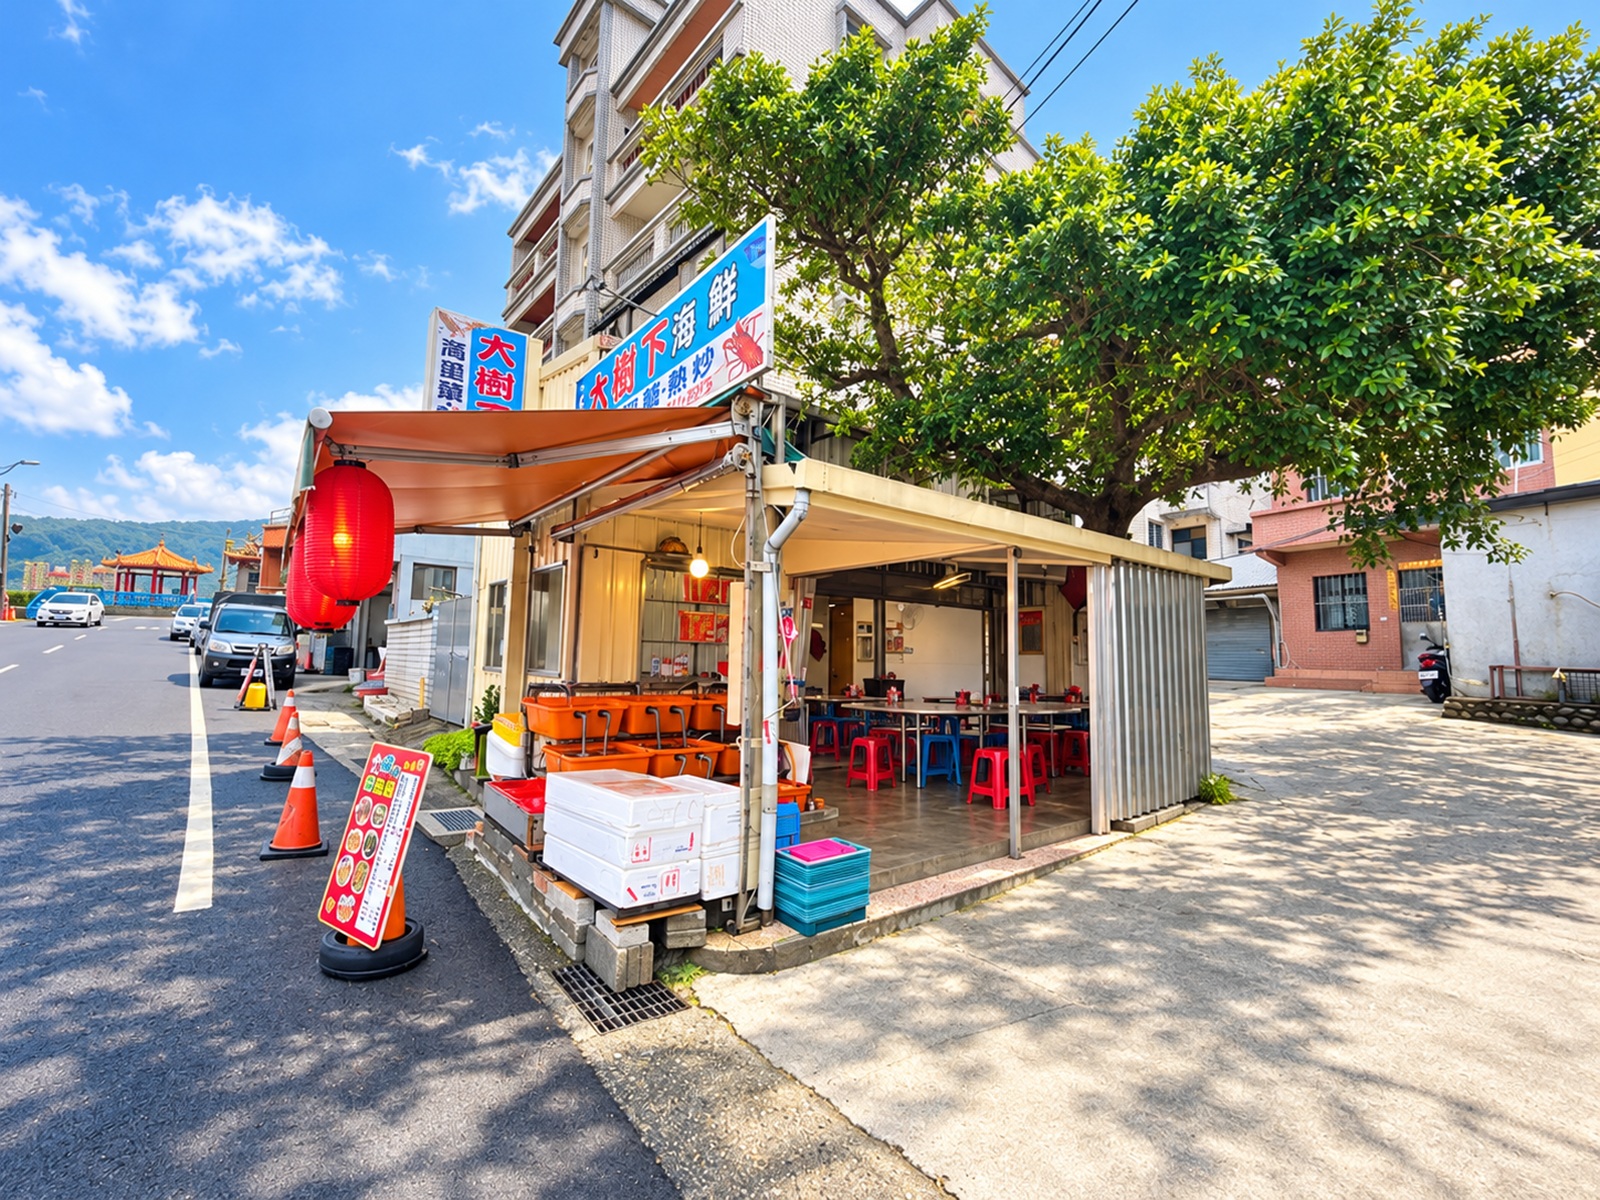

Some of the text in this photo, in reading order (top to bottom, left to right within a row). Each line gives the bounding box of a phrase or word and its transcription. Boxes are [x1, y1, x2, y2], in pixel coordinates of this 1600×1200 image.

[588, 262, 738, 410] 大樹下海鮮
